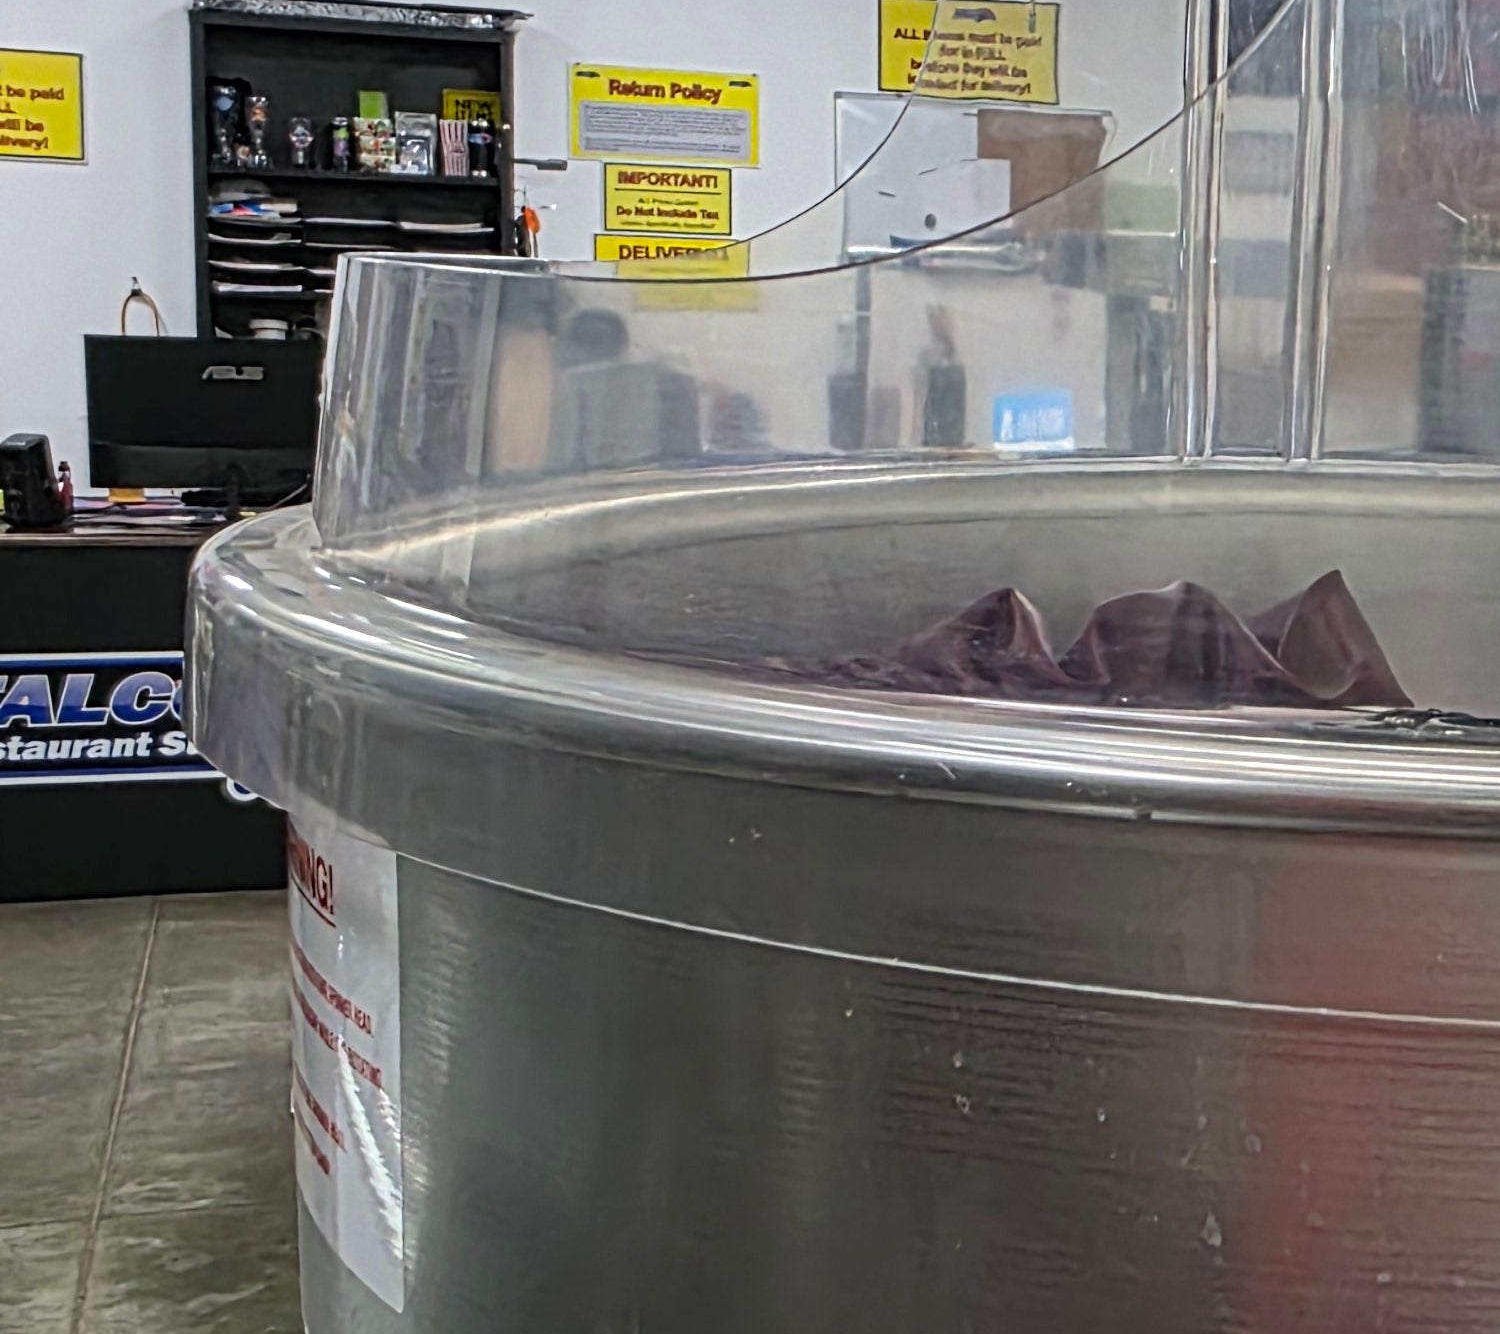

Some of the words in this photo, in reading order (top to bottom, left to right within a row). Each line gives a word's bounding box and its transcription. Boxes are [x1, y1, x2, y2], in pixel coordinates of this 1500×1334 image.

[30, 88, 64, 102] paid
[608, 79, 665, 98] Return
[670, 83, 722, 105] Policy
